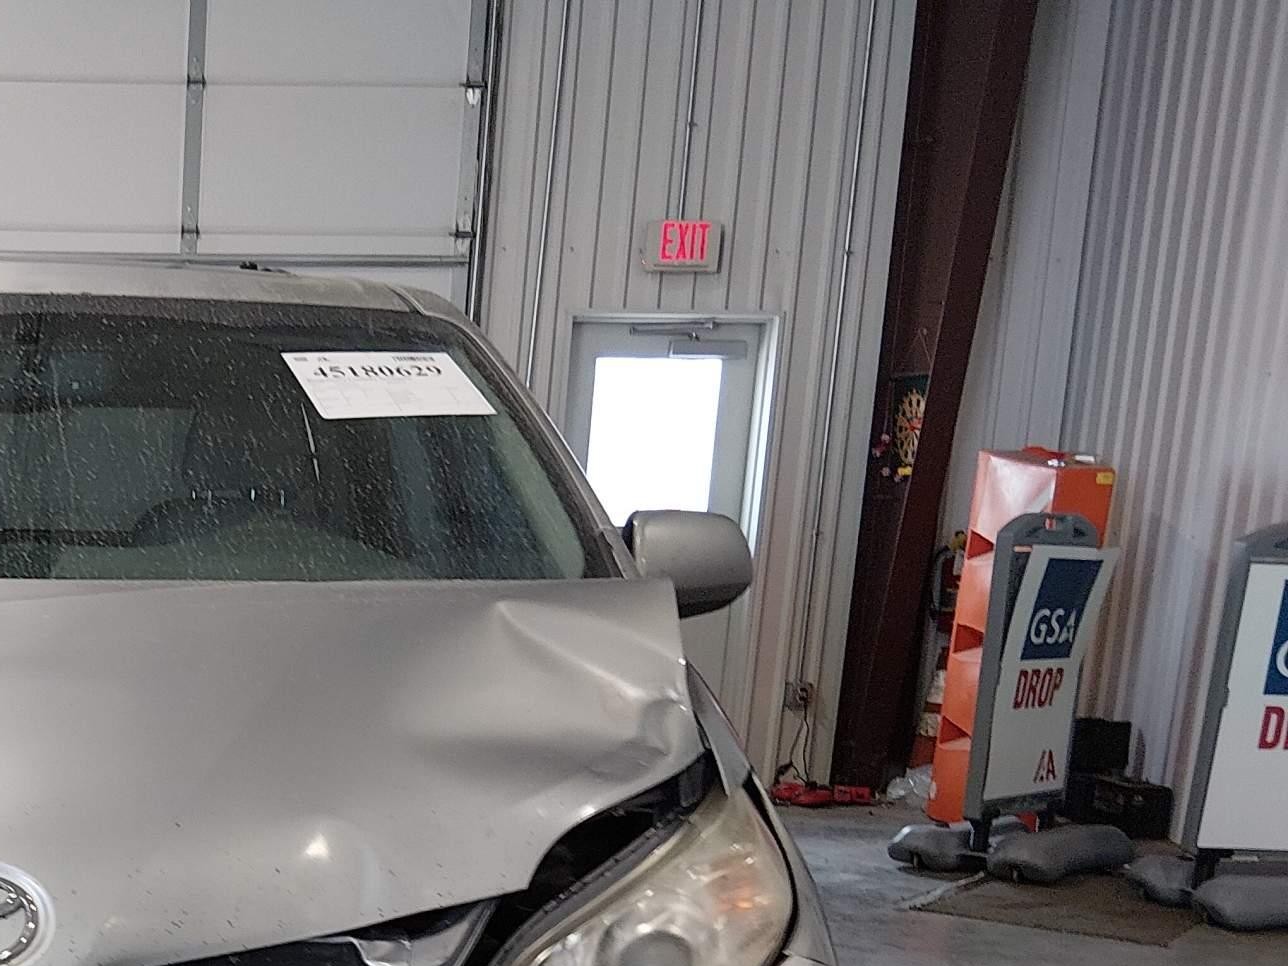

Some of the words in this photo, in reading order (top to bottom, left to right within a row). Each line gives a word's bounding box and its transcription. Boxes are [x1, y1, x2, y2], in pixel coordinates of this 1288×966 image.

[660, 222, 711, 261] EXIT
[313, 364, 443, 378] 45180629
[1030, 607, 1077, 645] GSA
[1013, 667, 1064, 709] DROP
